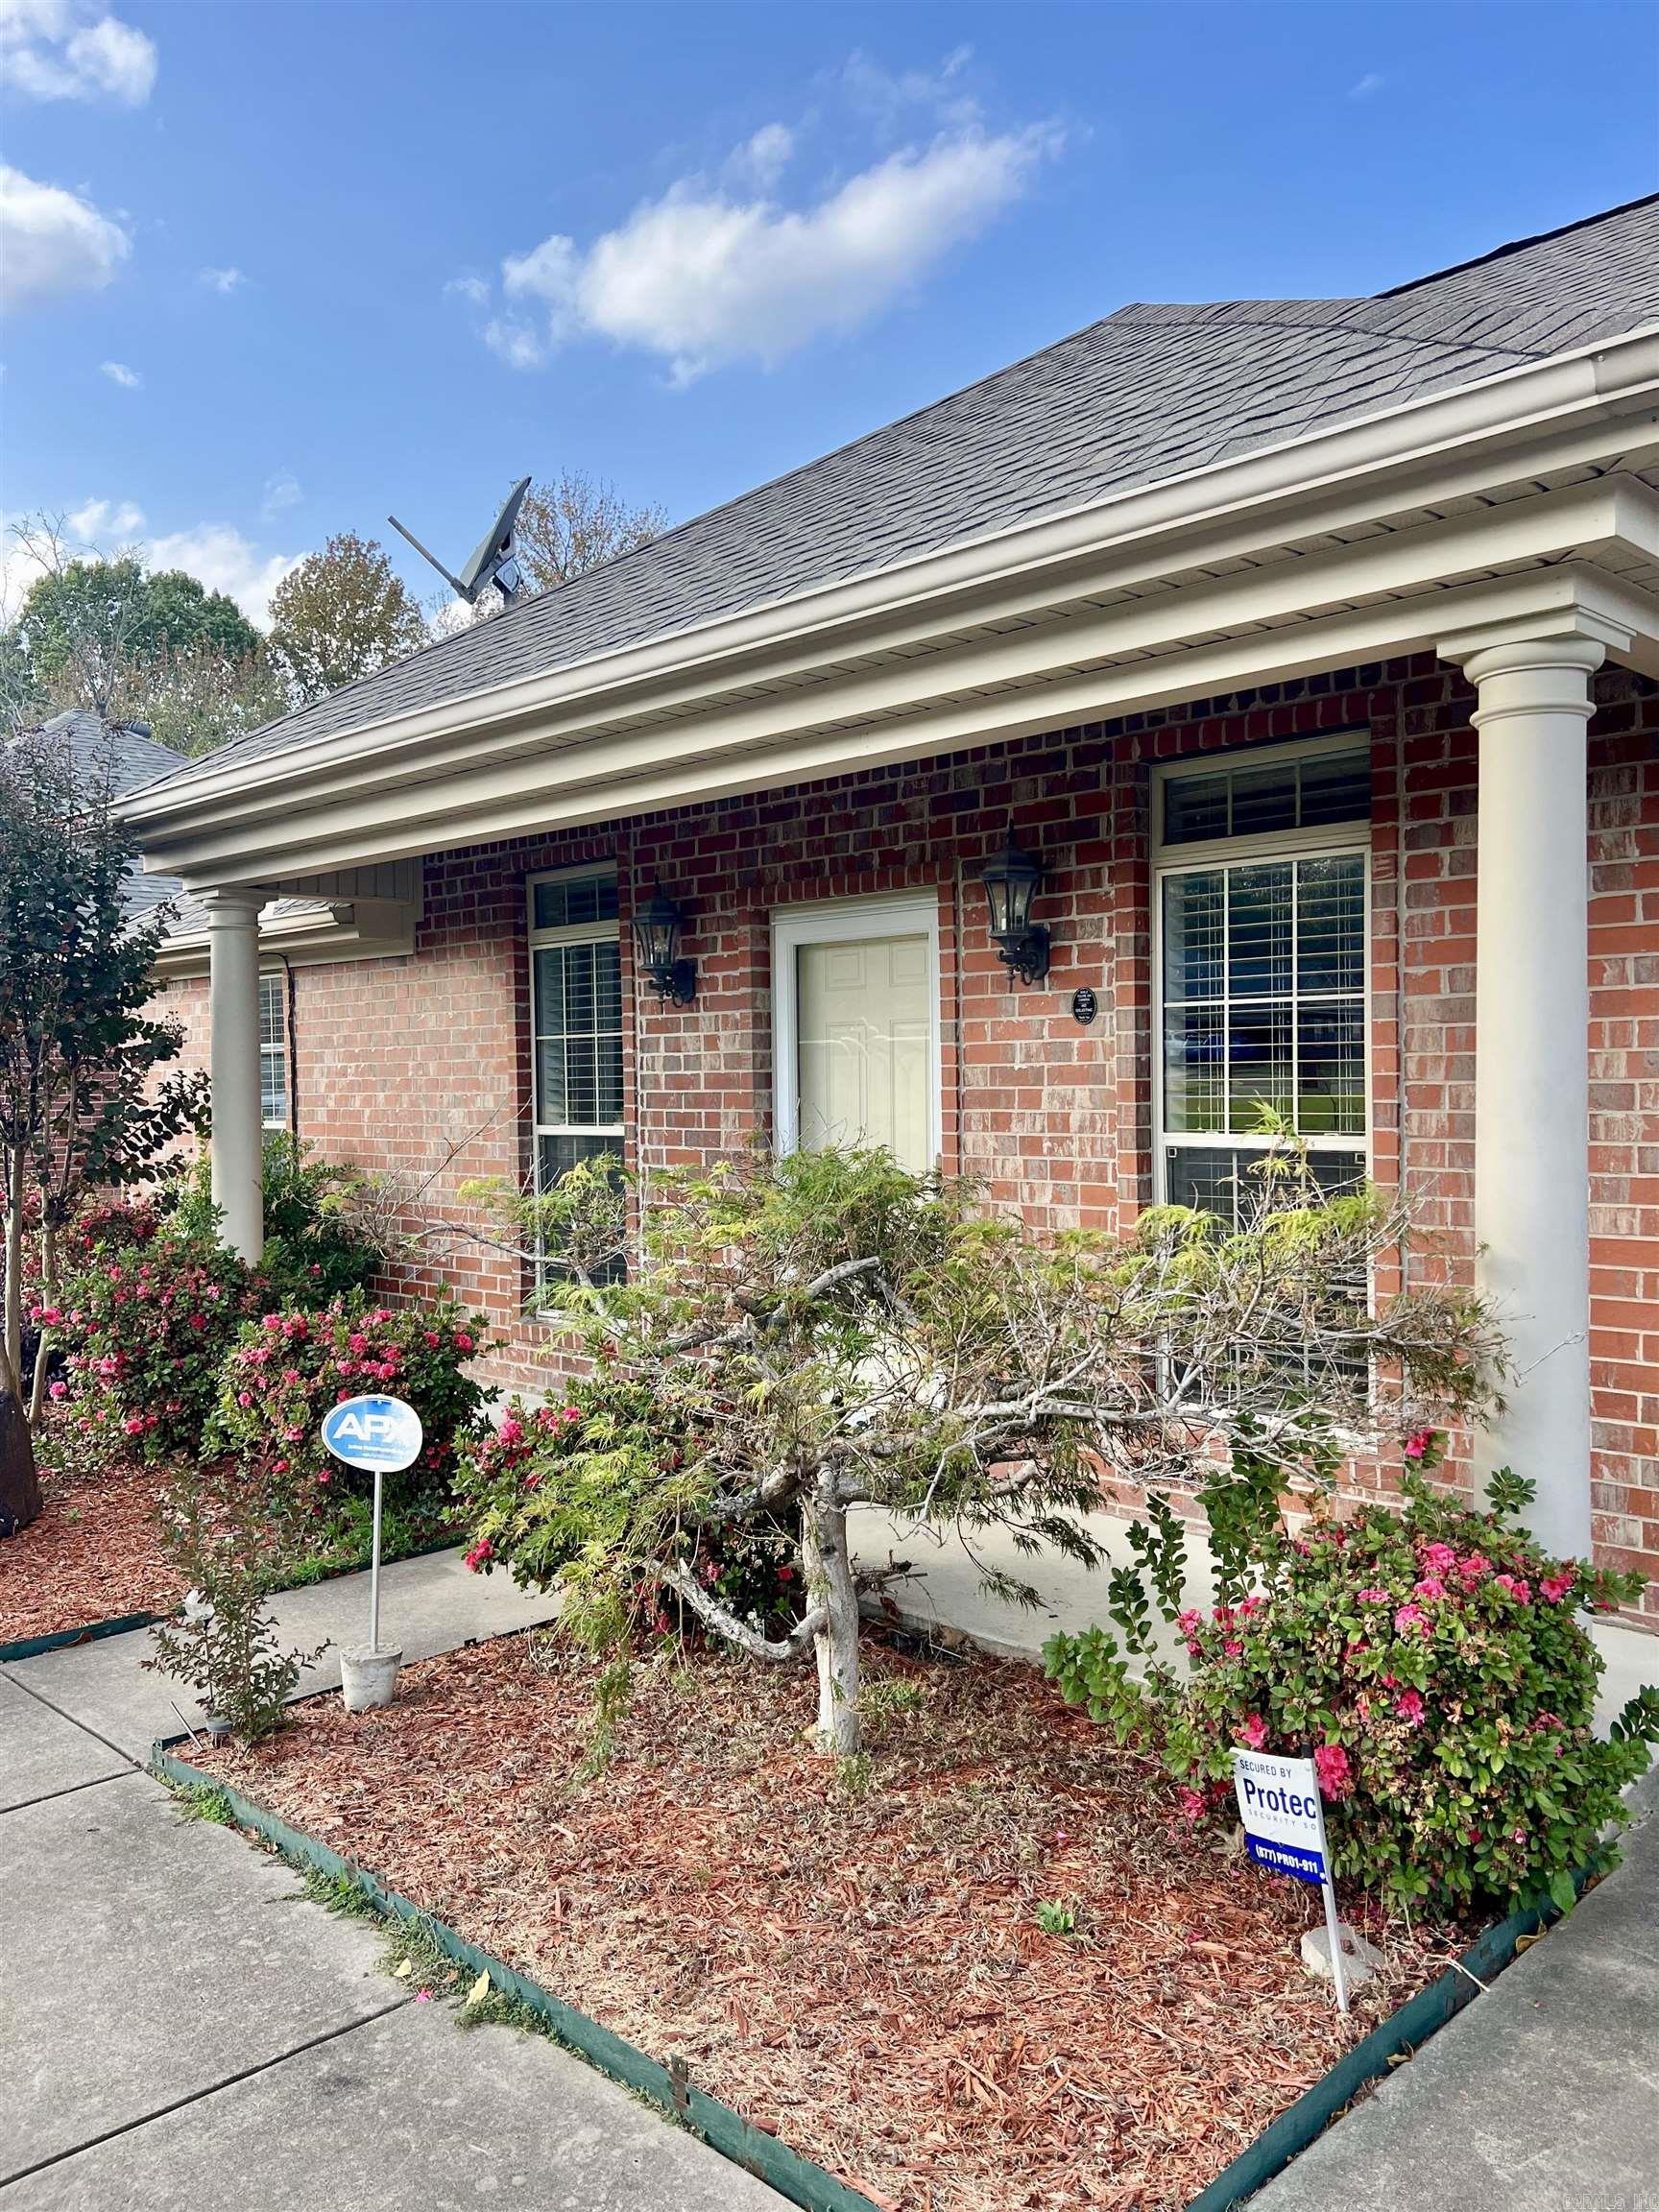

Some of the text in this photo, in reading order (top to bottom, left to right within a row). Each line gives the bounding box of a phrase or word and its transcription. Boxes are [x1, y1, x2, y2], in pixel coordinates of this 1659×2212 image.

[1239, 1759, 1291, 1778] SECURED BY
[1242, 1777, 1317, 1819] Protec
[1248, 1808, 1296, 1826] SECURITY
